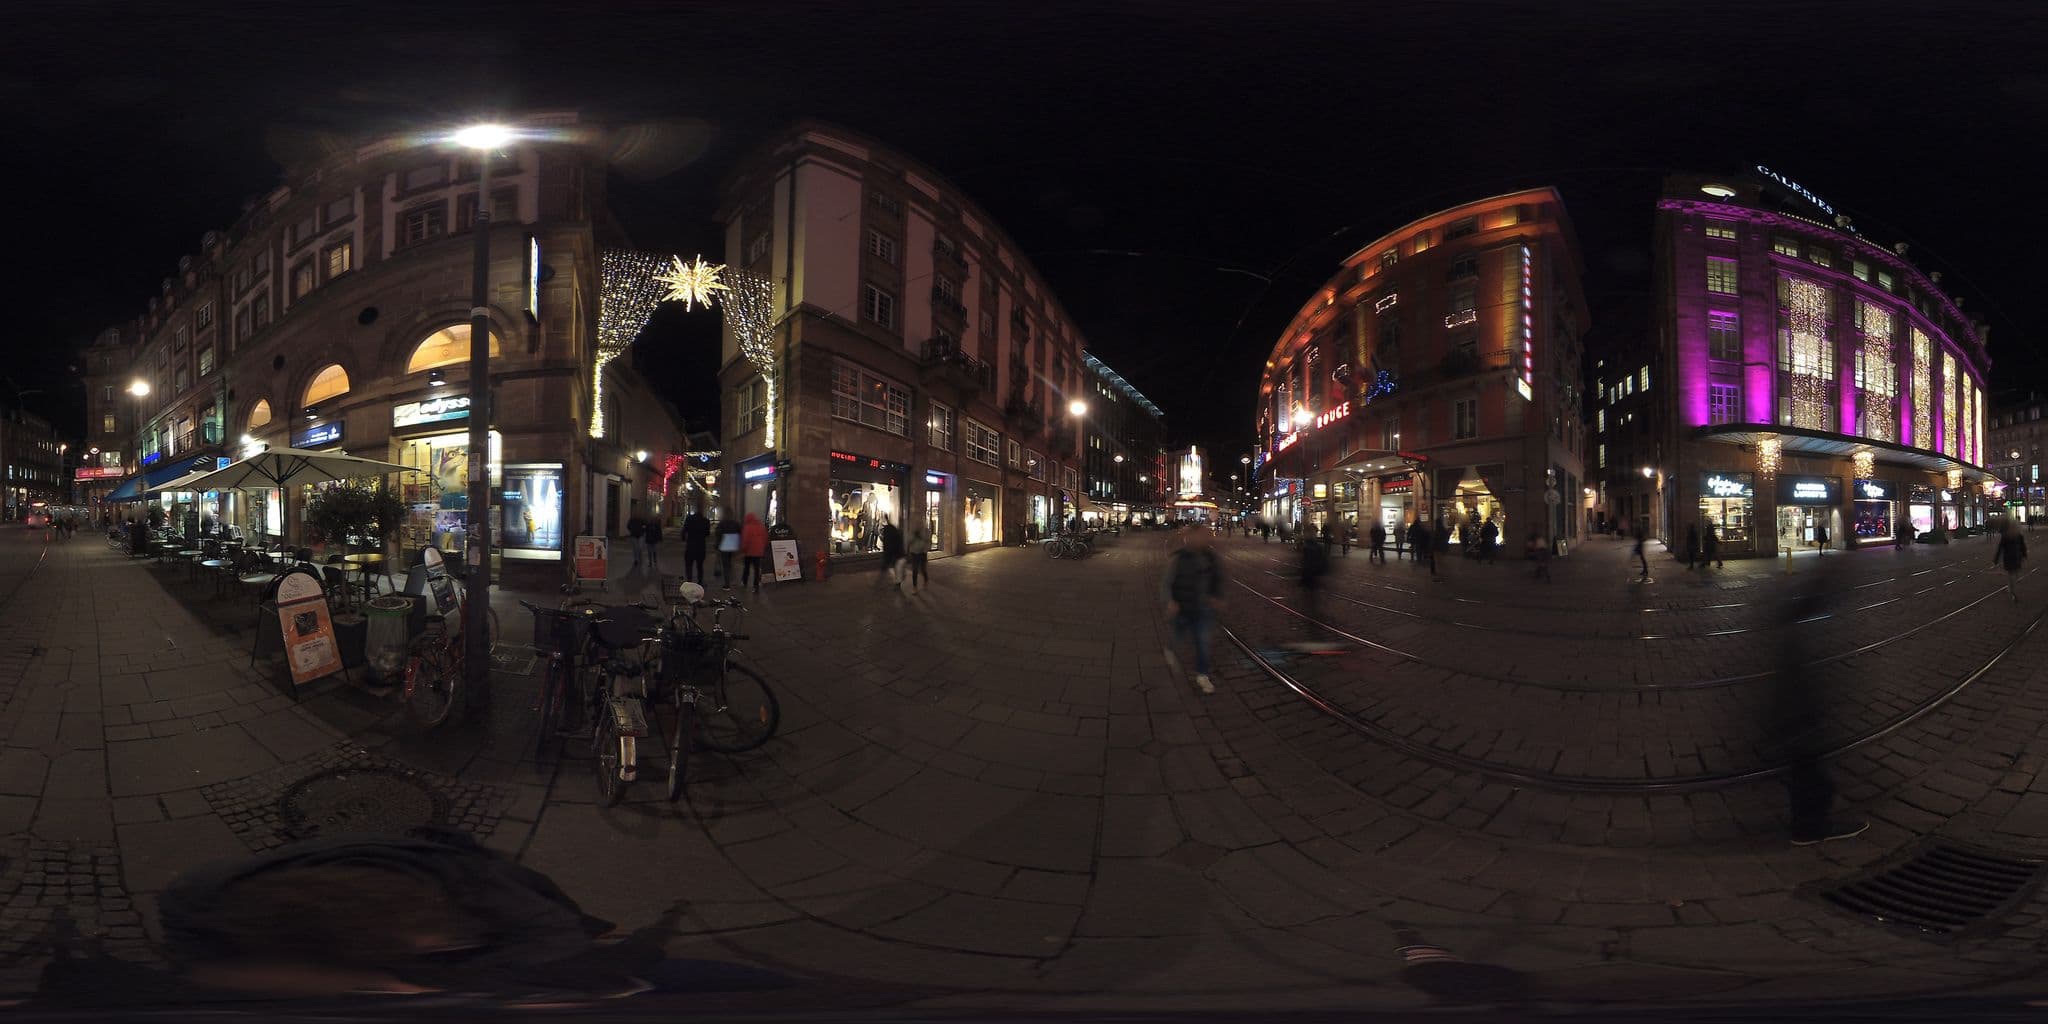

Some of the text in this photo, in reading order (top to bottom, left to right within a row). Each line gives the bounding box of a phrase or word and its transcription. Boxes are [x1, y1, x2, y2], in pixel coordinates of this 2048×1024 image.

[1757, 165, 1833, 215] GALERIES
[420, 397, 470, 414] odyss
[1316, 401, 1350, 429] ROUGE
